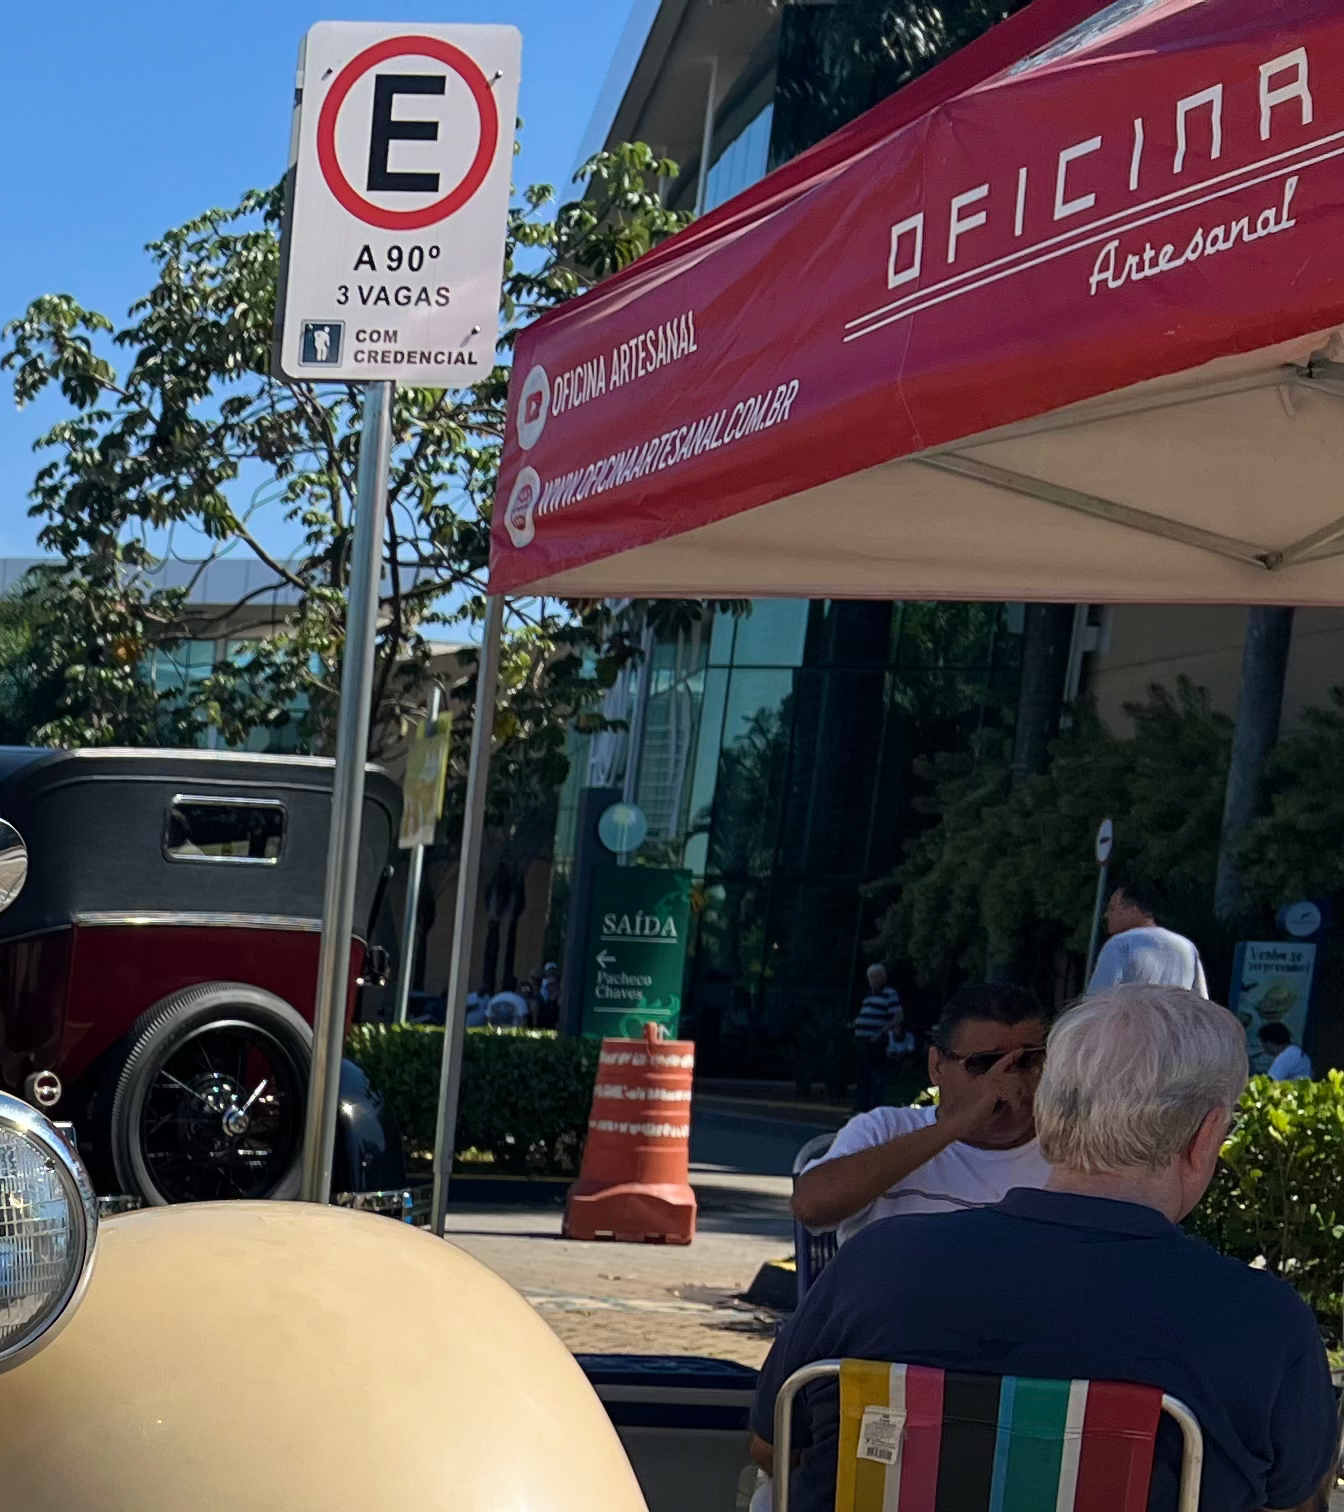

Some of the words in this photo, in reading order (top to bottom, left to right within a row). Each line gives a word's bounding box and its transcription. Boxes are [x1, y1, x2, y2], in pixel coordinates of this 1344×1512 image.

[367, 74, 447, 193] E
[887, 46, 1313, 290] OFICINA
[353, 244, 376, 273] A
[1089, 175, 1299, 296] Artesanal
[336, 285, 350, 306] 3
[356, 285, 451, 308] VAGAS
[353, 350, 478, 366] CREDENCIAL
[355, 329, 399, 345] COM
[551, 355, 606, 417] OFICINA
[609, 310, 698, 391] ARTESANAL
[537, 379, 800, 517] WWW.OFICINAARTESANAL.COM.BR
[602, 909, 678, 937] SAÍDA
